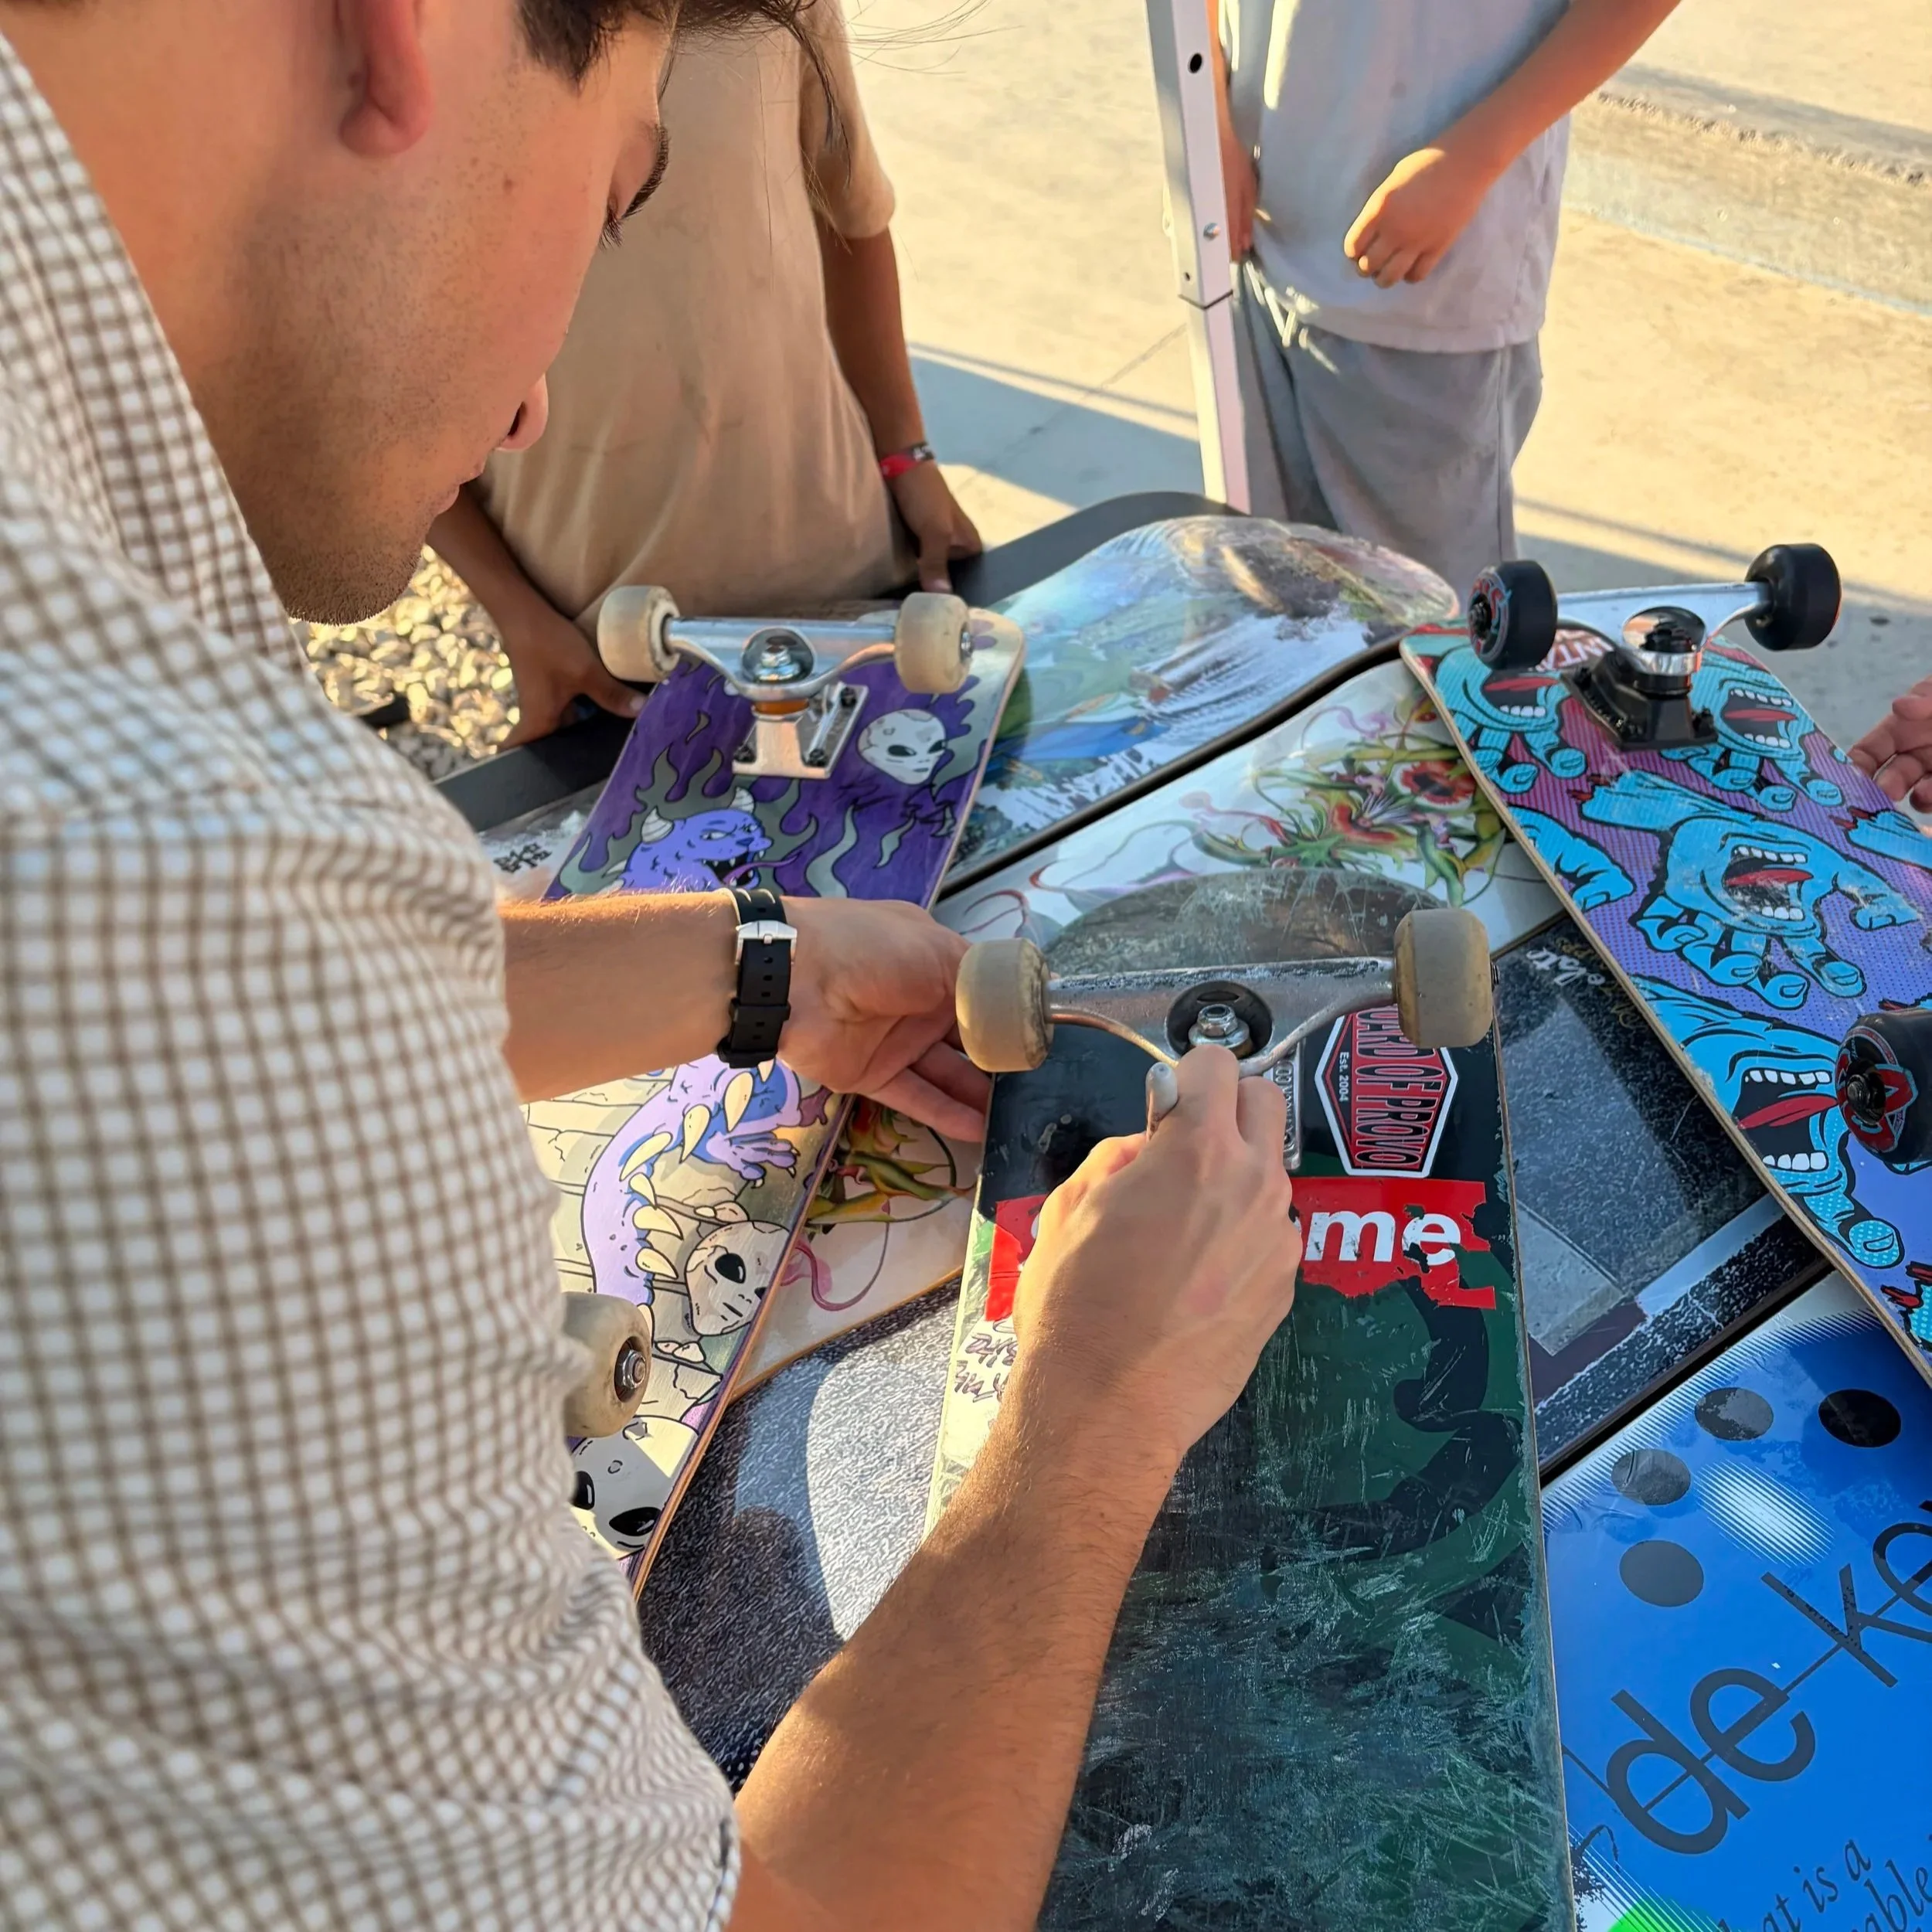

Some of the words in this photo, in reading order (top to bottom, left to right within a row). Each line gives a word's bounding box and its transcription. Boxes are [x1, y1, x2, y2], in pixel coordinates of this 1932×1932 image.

[1355, 1004, 1435, 1060] OARD
[1338, 1051, 1349, 1072] Est.
[1338, 1074, 1349, 1102] 2004
[1355, 1064, 1444, 1092] OF
[1355, 1095, 1439, 1165] PROVO
[1295, 1210, 1461, 1266] me
[1792, 1866, 1838, 1914] is
[1844, 1839, 1872, 1882] a
